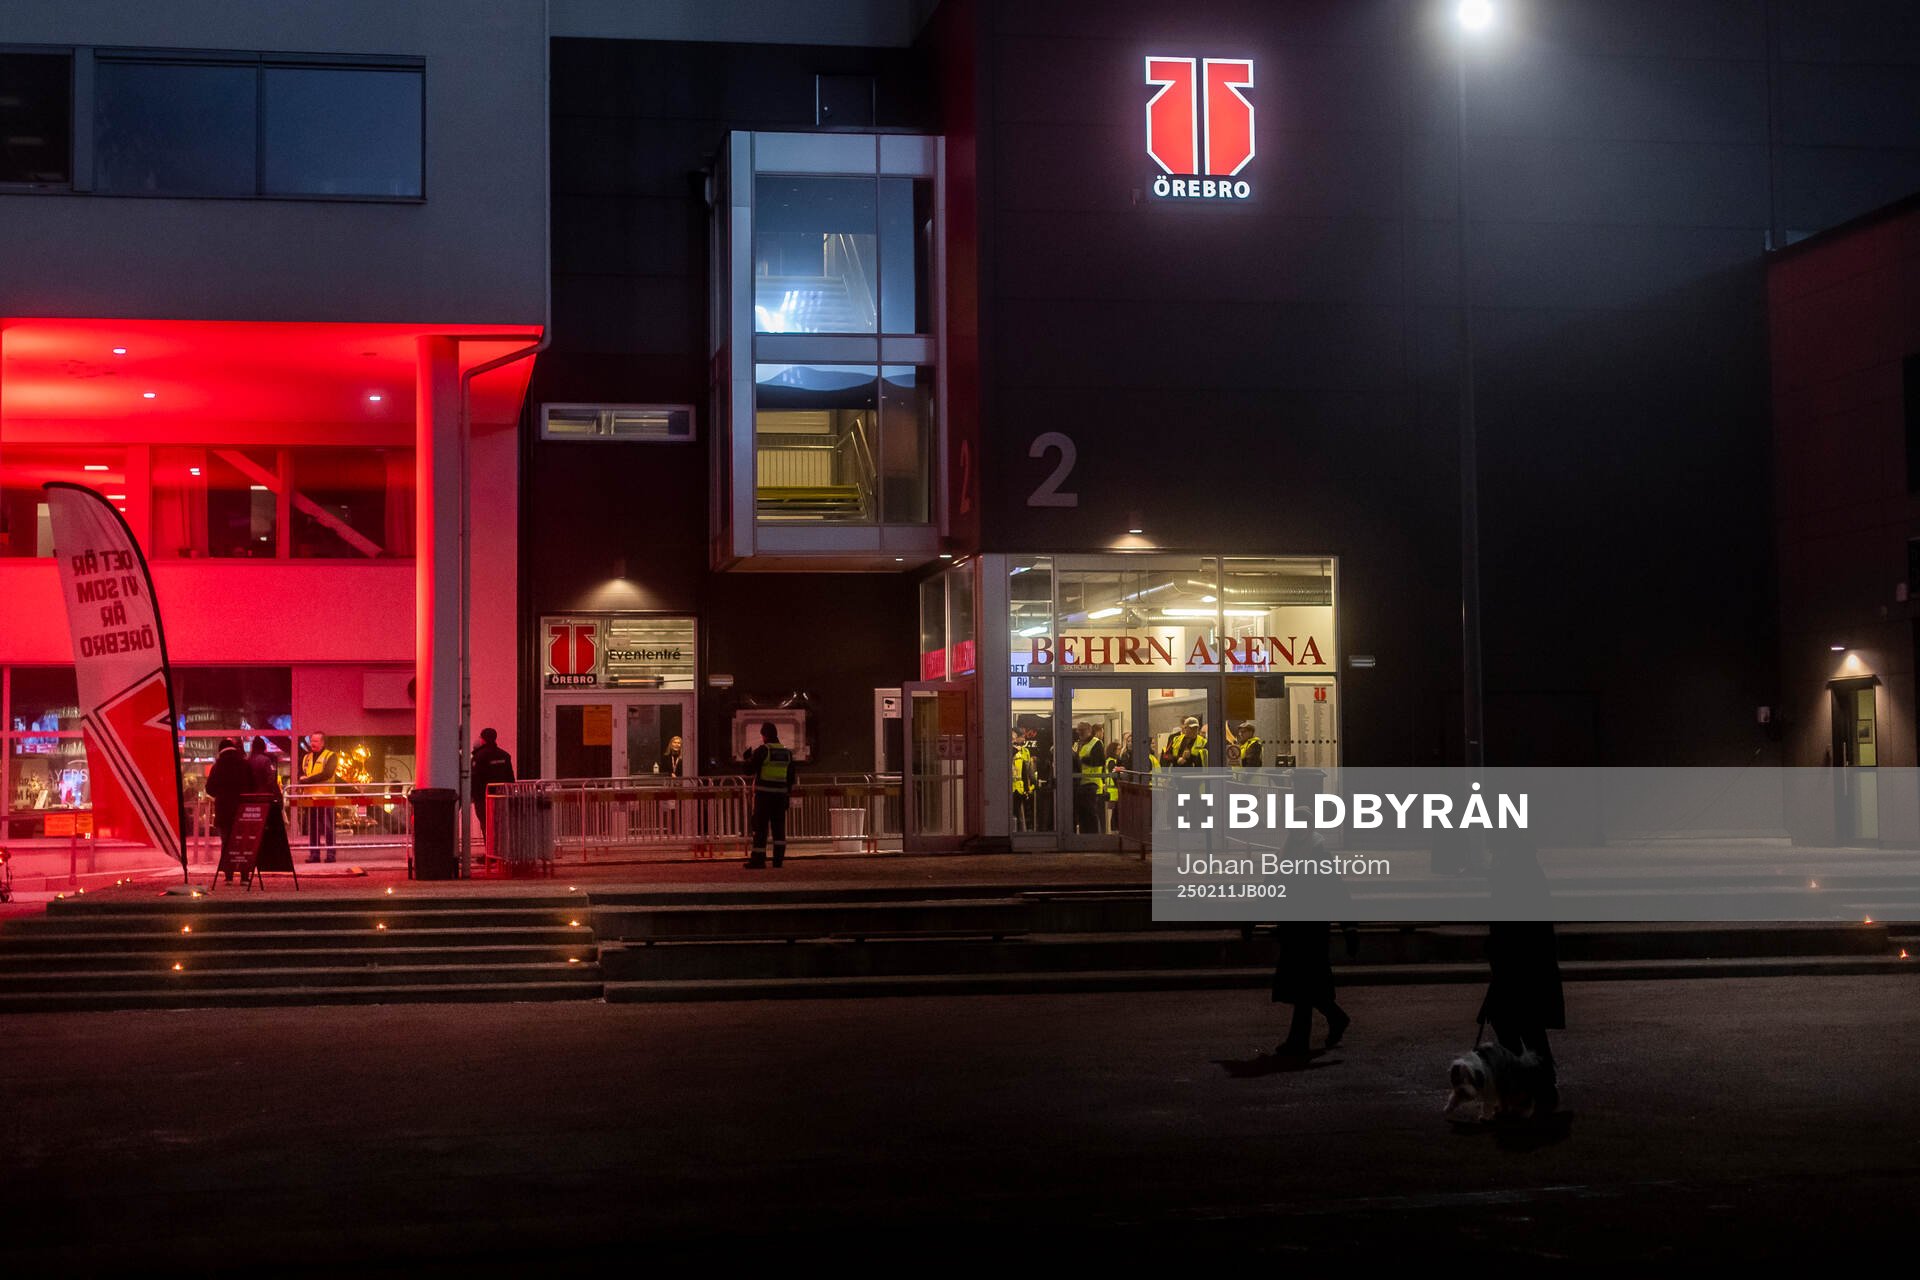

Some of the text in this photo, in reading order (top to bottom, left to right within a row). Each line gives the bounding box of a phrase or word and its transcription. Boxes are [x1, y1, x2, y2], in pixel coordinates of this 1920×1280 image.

[1153, 175, 1251, 198] ÖREBRO
[1026, 431, 1078, 507] 2
[609, 647, 681, 660] Evententré
[1028, 634, 1326, 666] BEHRN ARENA
[552, 675, 594, 684] ÖREBRO
